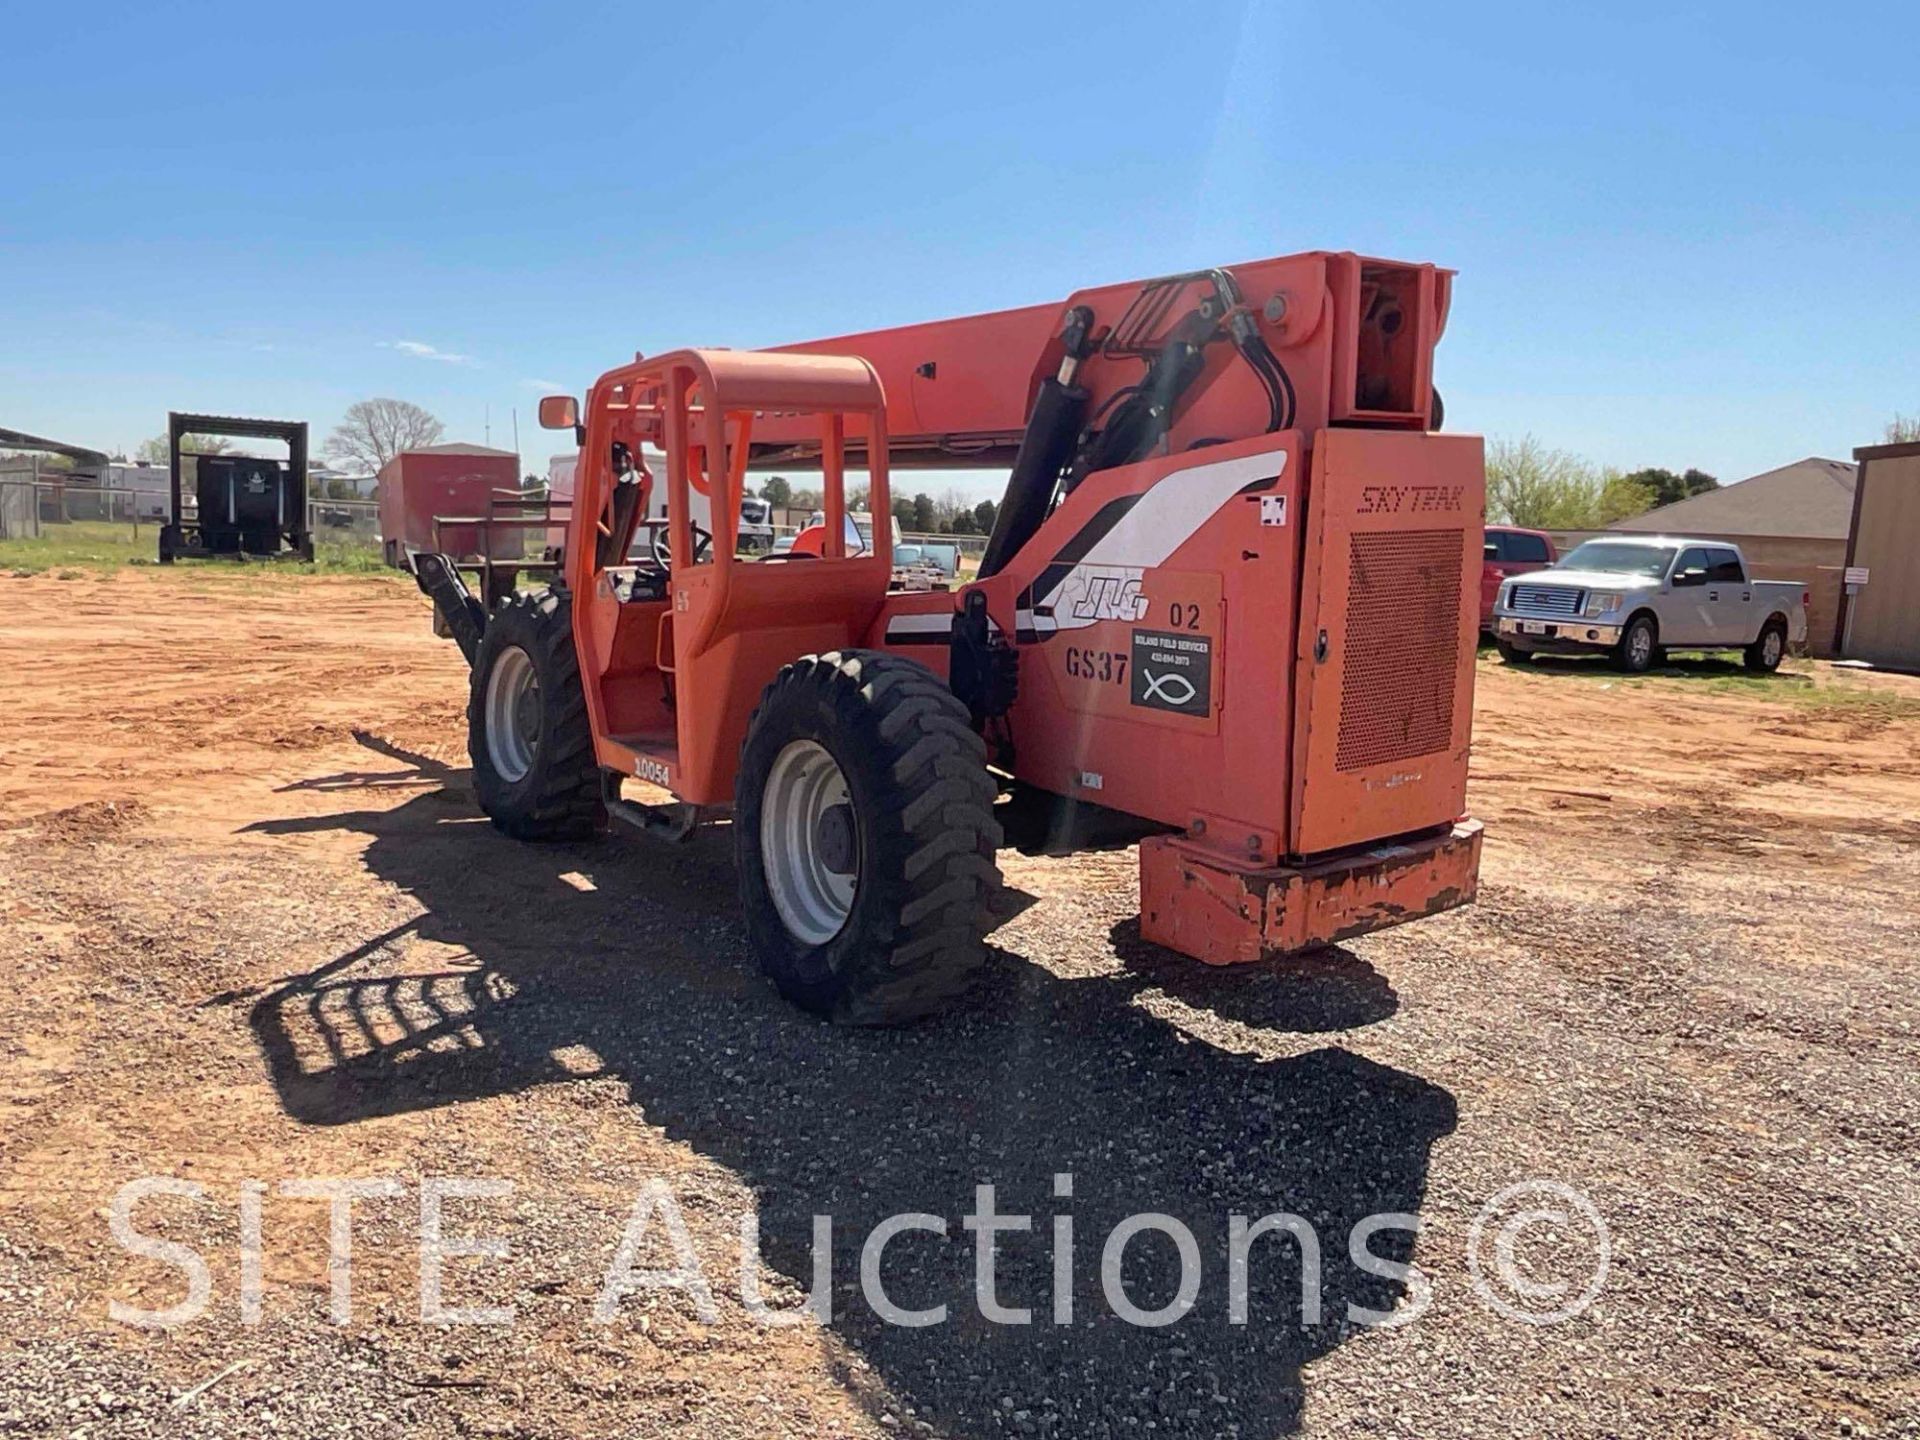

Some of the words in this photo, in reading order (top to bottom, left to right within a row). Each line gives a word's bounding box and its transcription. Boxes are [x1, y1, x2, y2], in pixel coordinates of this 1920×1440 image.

[1073, 577, 1149, 622] JLG
[1170, 603, 1200, 630] 02
[1178, 640, 1208, 653] SERVICES
[1066, 647, 1128, 685] GS37
[634, 757, 669, 786] 10054
